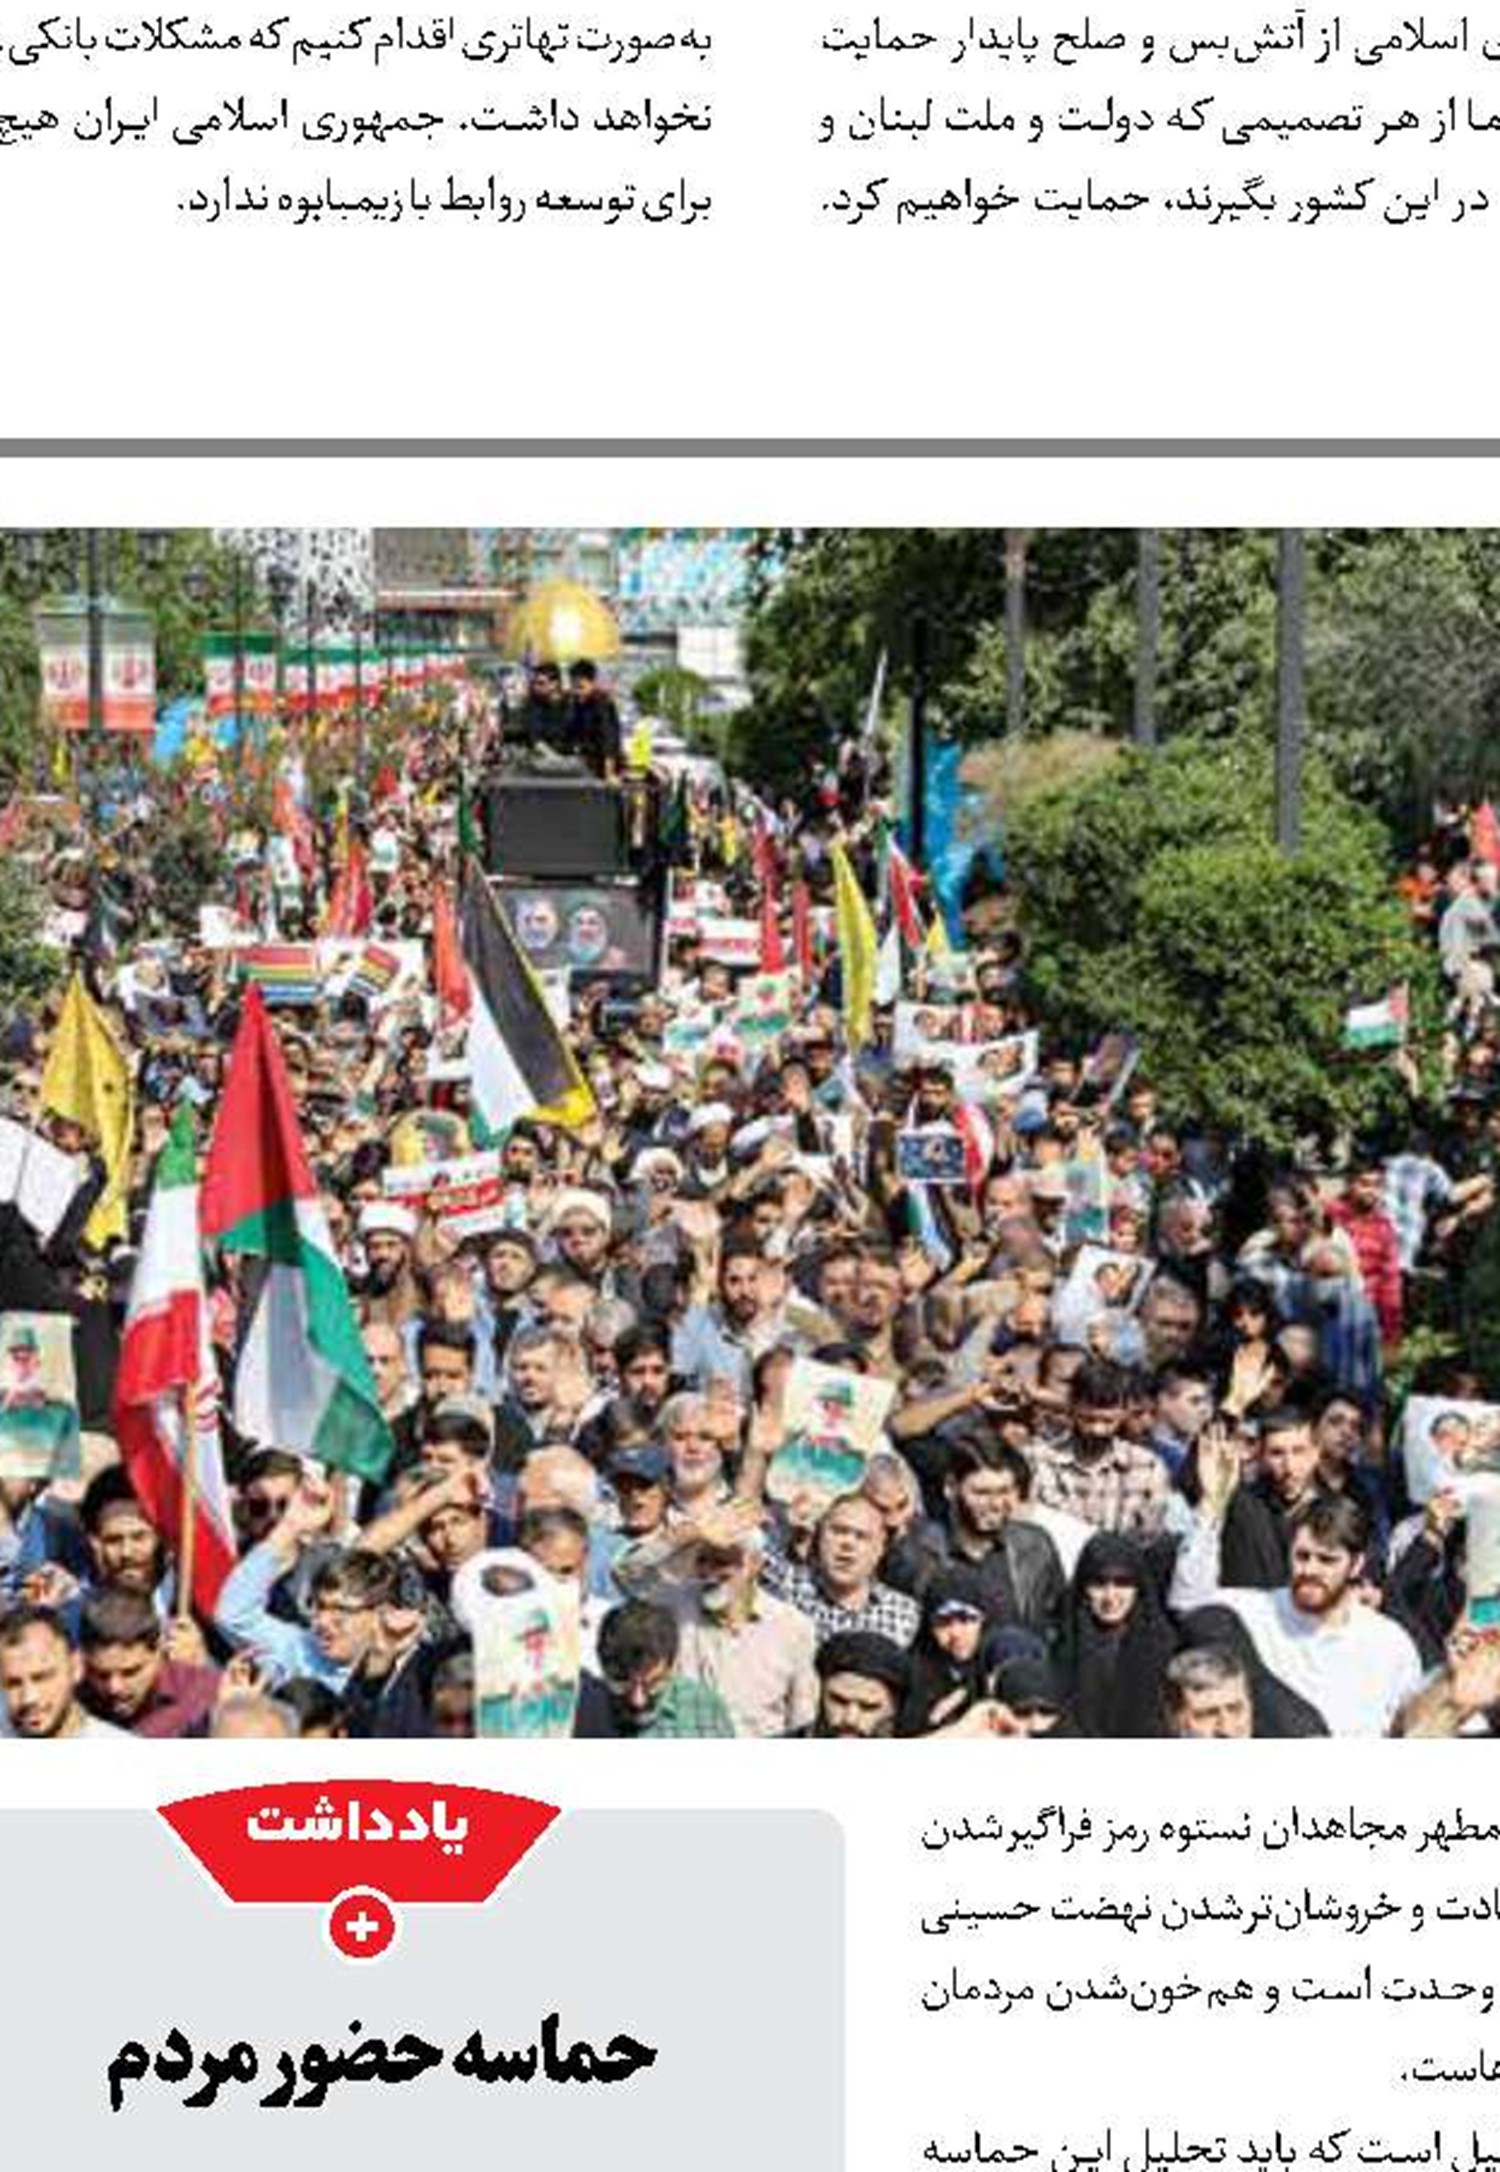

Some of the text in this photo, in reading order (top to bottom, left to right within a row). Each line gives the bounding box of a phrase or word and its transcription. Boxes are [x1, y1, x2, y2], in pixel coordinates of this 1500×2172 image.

[106, 17, 242, 52] مشکلات
[250, 17, 290, 49] که
[293, 17, 371, 66] کنیم
[375, 17, 454, 66] اقدام
[462, 17, 570, 66] تهاتری
[823, 17, 938, 61] حمایت
[951, 17, 1039, 64] پایدار
[1054, 17, 1126, 66] صلح
[1141, 36, 1155, 64] و
[1315, 17, 1340, 64] از
[1355, 17, 1468, 66] اسلامی
[74, 96, 158, 146] ایران
[173, 96, 288, 146] اسلامی
[303, 111, 444, 146] جمهوری
[460, 99, 579, 131] داشت.
[594, 98, 712, 145] نخواهد
[819, 115, 834, 143] و
[850, 96, 933, 141] لبنان
[946, 99, 1015, 131] ملت
[1028, 115, 1044, 143] و
[1059, 96, 1155, 143] دولت
[1167, 96, 1215, 131] که
[1223, 106, 1364, 146] تصمیمی
[1374, 111, 1420, 146] هر
[1430, 96, 1456, 143] از
[178, 176, 712, 225] برای توسعه روابط با زیمبابوه ندارد.
[823, 178, 889, 225] کرد.
[898, 178, 1020, 225] خواهیم
[1035, 178, 1150, 221] حمایت
[1288, 178, 1376, 225] کشور
[1384, 178, 1439, 225] این
[1452, 190, 1489, 223] در
[246, 1796, 469, 1855] یادداشت
[1103, 1820, 1150, 1853] رمز
[1160, 1813, 1251, 1853] نستوه
[1264, 1806, 1408, 1851] مجاهدان
[922, 1900, 1041, 1935] حسینی
[1052, 1895, 1152, 1935] نهضت
[1411, 1904, 1424, 1933] و
[1437, 1888, 1500, 1920] ادت
[922, 1967, 1034, 2014] مردمان
[1264, 1986, 1280, 2014] و
[1293, 1965, 1371, 2002] است
[1382, 1979, 1494, 2014] وحدت
[107, 2012, 658, 2113] حماسه حضور مردم
[924, 2130, 1039, 2164] حماسه
[1309, 2129, 1352, 2164] که
[1358, 2130, 1441, 2164] است
